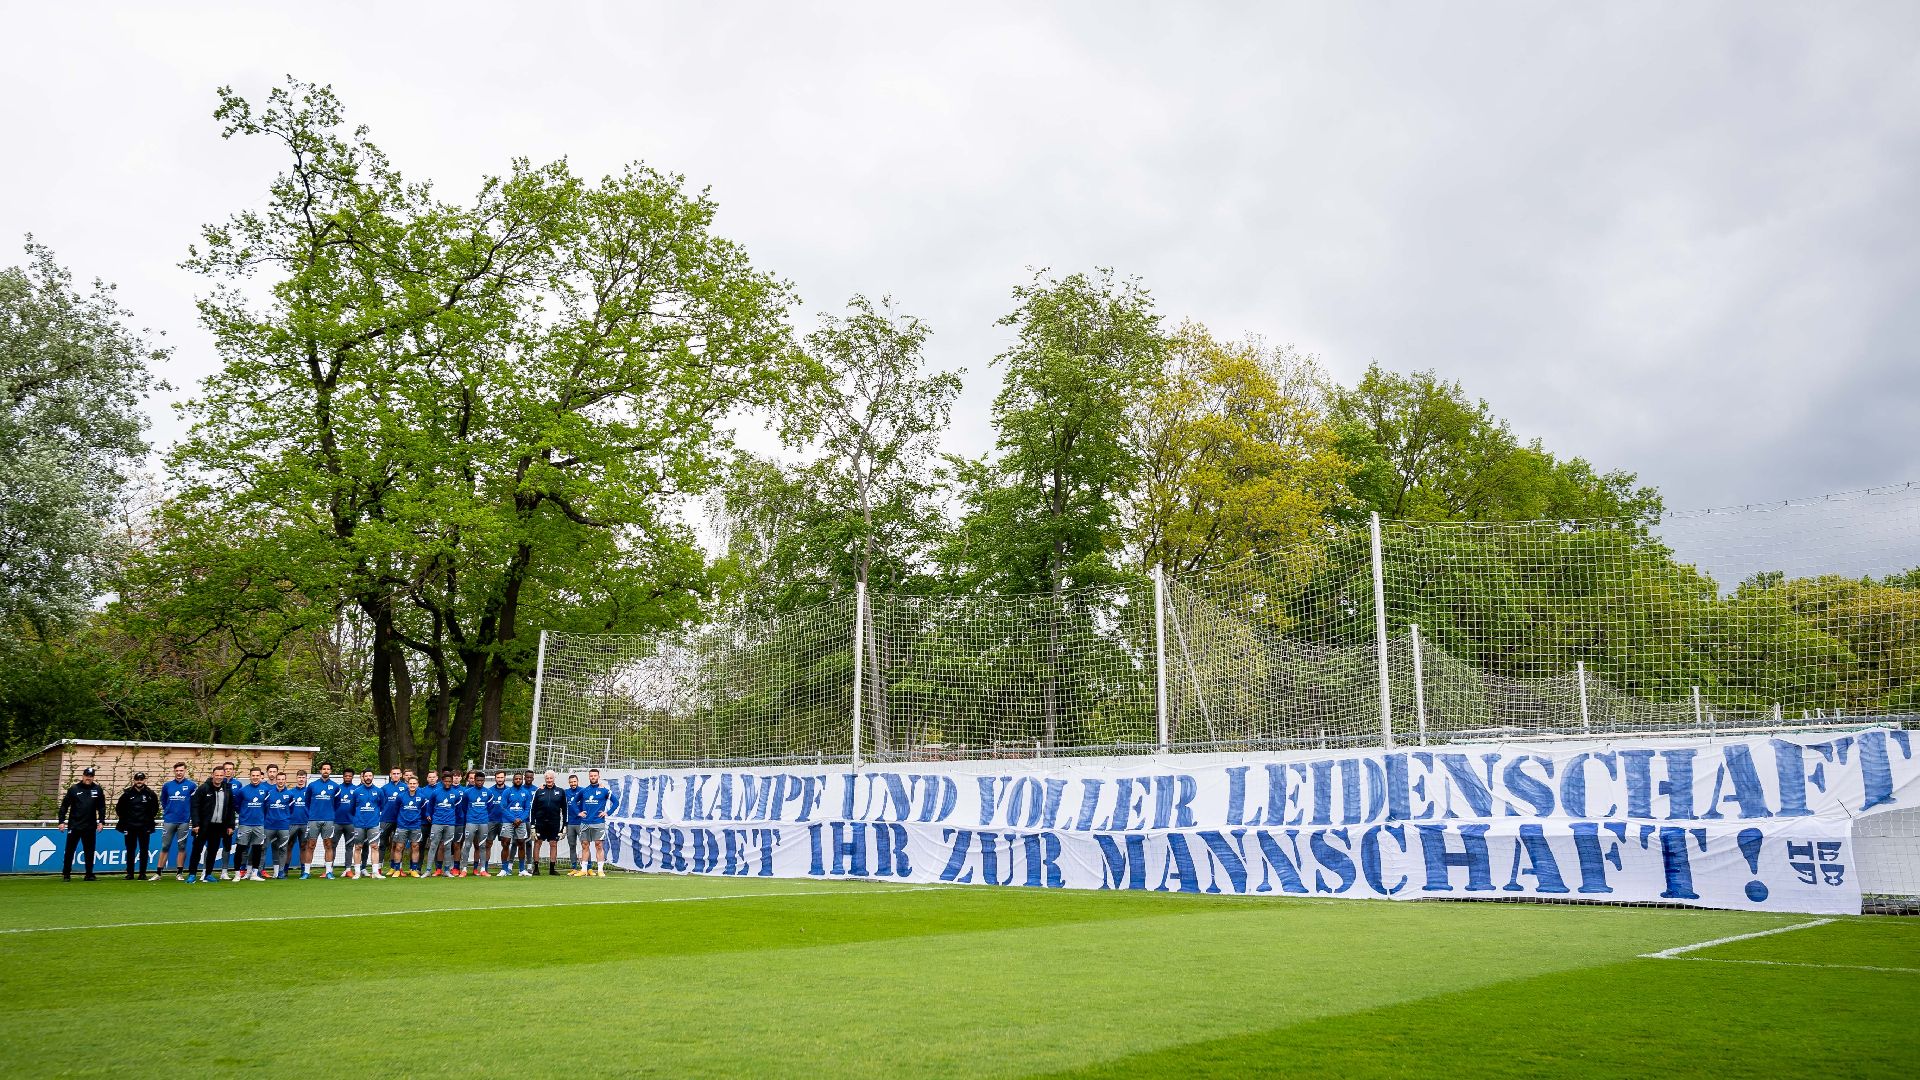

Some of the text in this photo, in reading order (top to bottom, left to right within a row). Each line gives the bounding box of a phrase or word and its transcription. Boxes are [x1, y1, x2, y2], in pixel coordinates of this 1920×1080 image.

[682, 773, 827, 822] KAMPF
[841, 772, 957, 822] UND
[976, 774, 1198, 830] VOLLER
[1225, 730, 1912, 826] LEIDENSCHAFT
[63, 849, 159, 865] OMEDY
[808, 821, 913, 878] IHR
[939, 828, 1066, 889] ZUR
[1093, 822, 1707, 899] MANNSCHAFT
